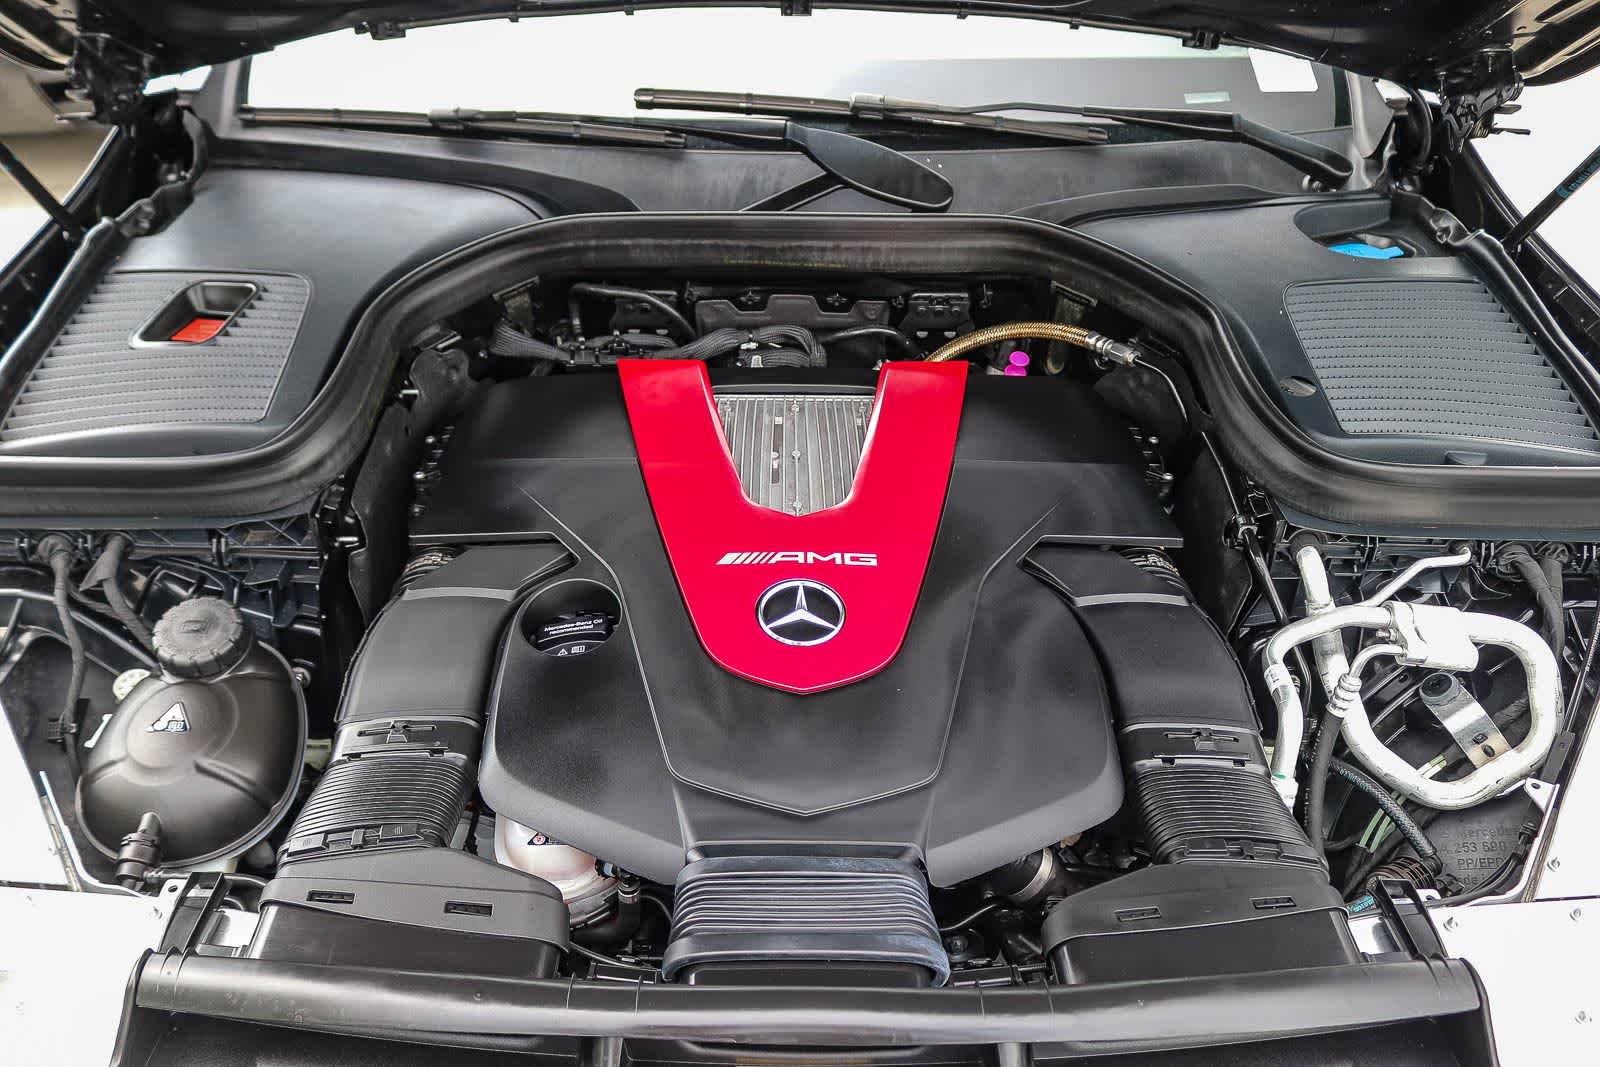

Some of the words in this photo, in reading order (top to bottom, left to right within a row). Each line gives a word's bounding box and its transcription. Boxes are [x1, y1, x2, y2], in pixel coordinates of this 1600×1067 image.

[767, 551, 878, 566] AMG
[544, 620, 592, 632] Mercedes-Benz
[550, 624, 594, 635] recommended
